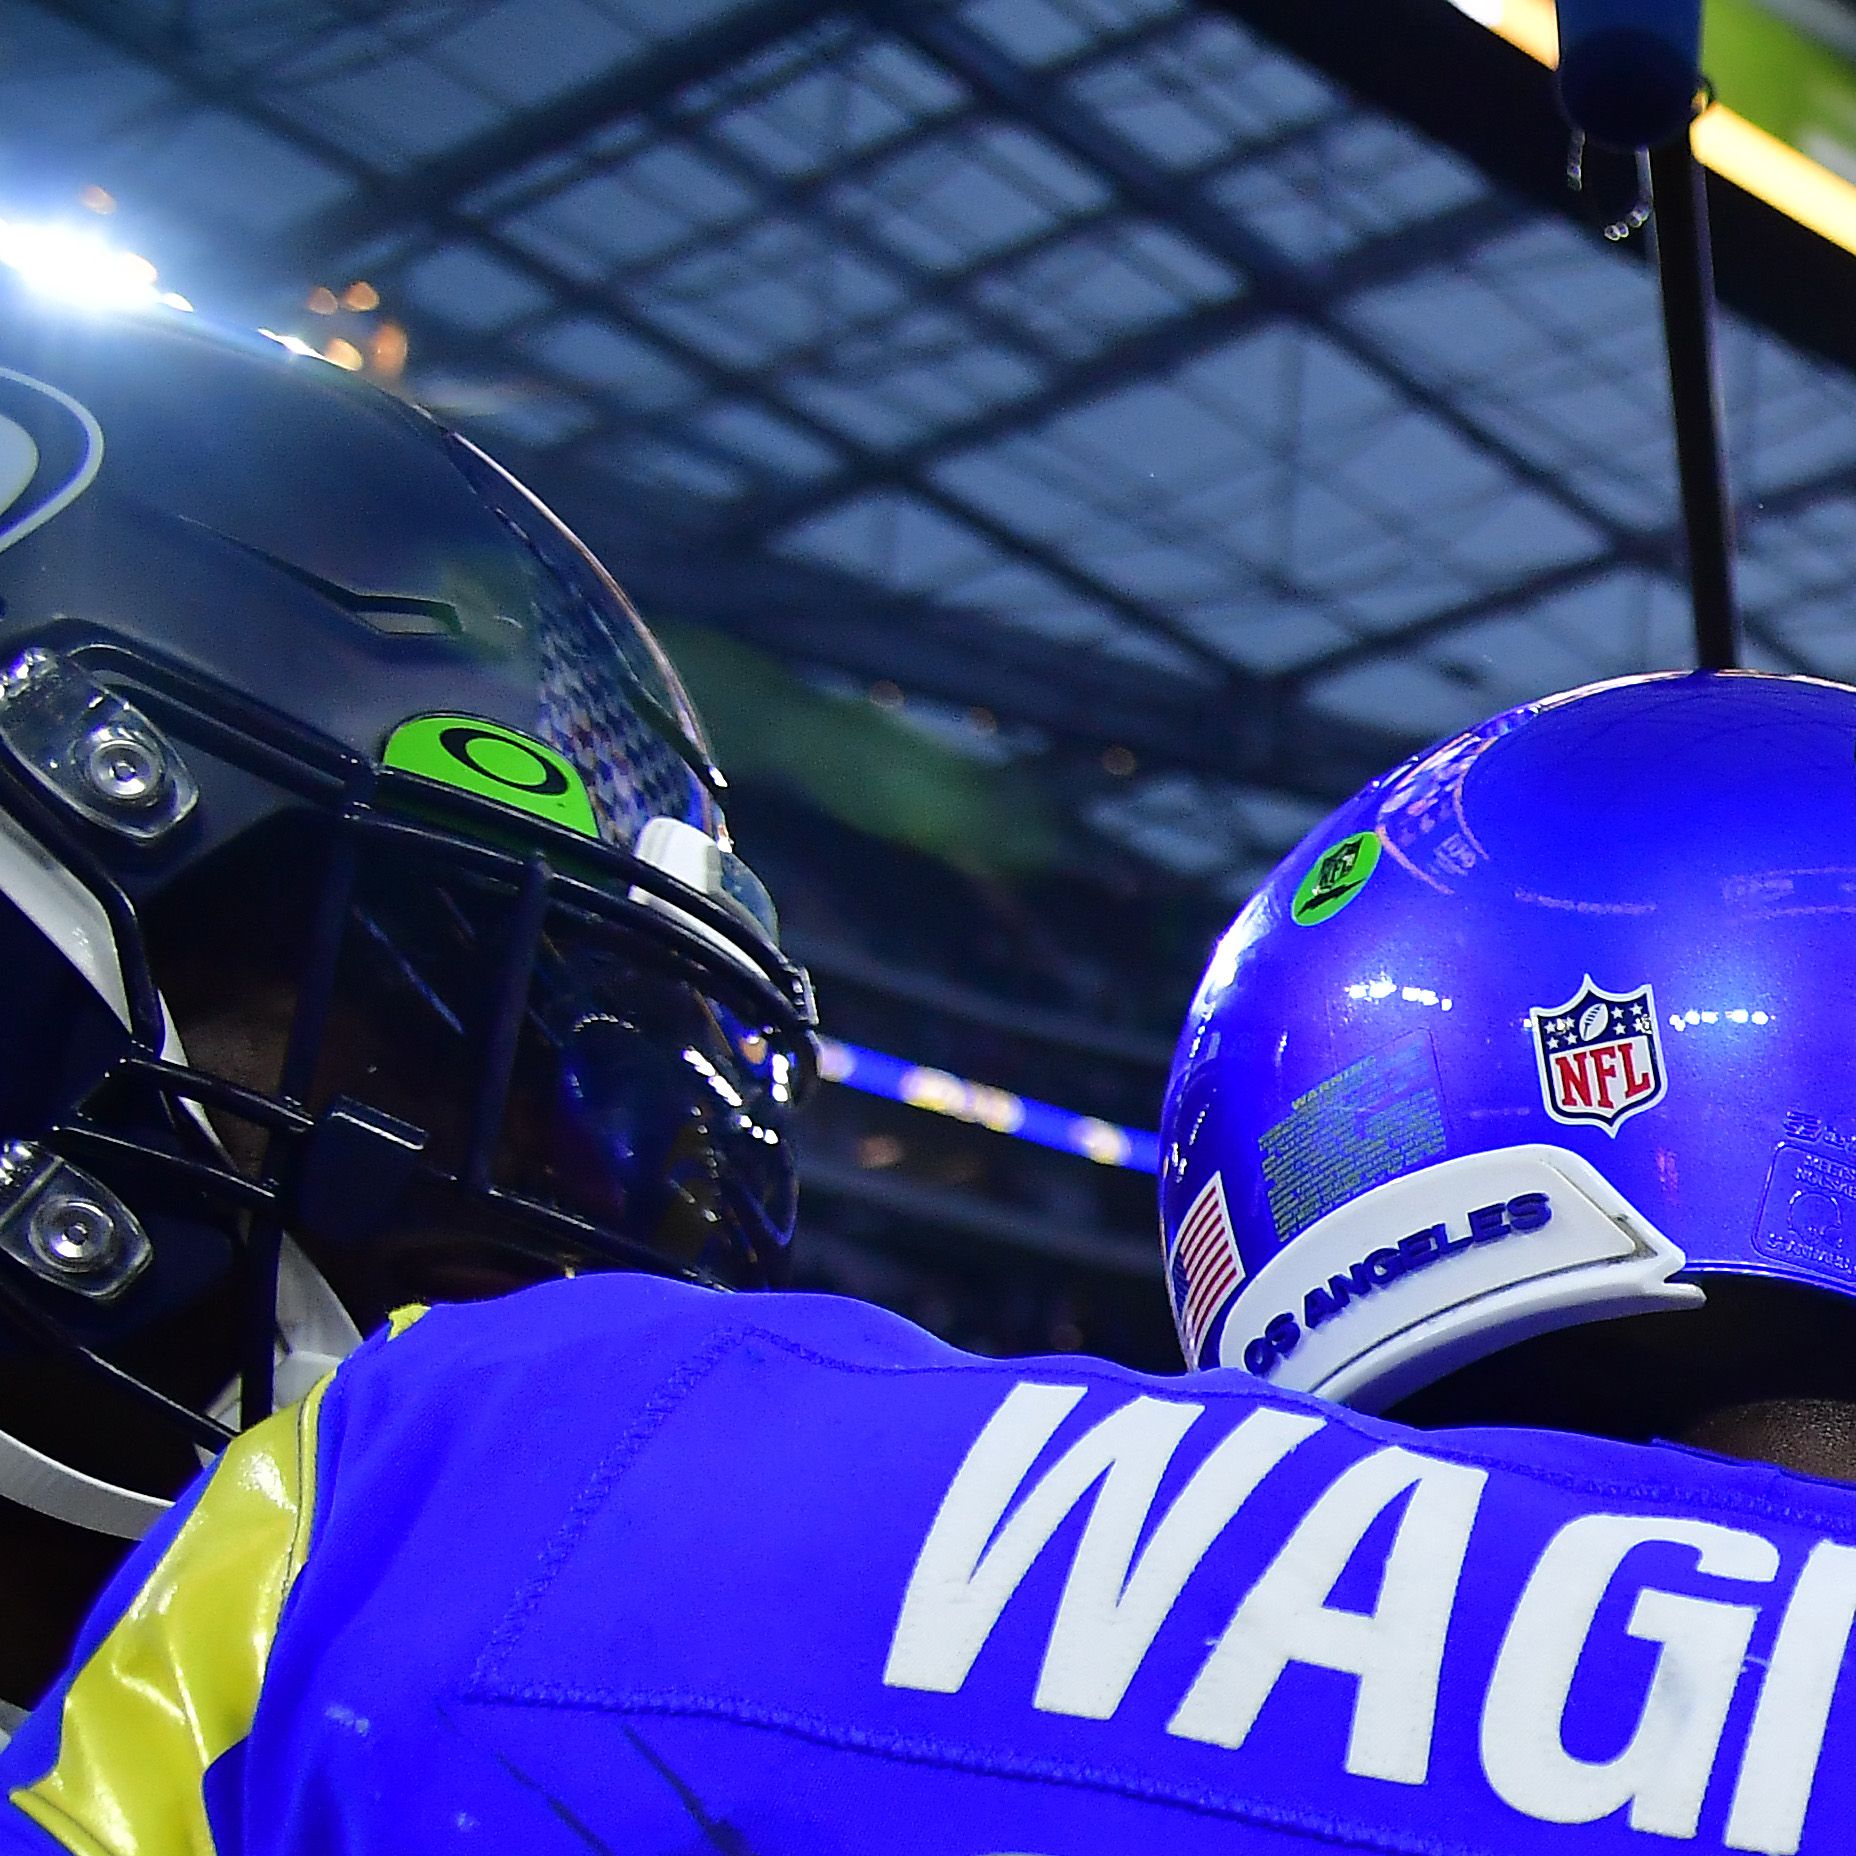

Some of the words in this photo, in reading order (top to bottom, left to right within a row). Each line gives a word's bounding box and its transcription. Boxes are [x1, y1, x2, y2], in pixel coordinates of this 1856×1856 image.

[1555, 1043, 1651, 1109] NFL
[1243, 1311, 1302, 1378] OS
[1303, 1191, 1553, 1330] ANGELES
